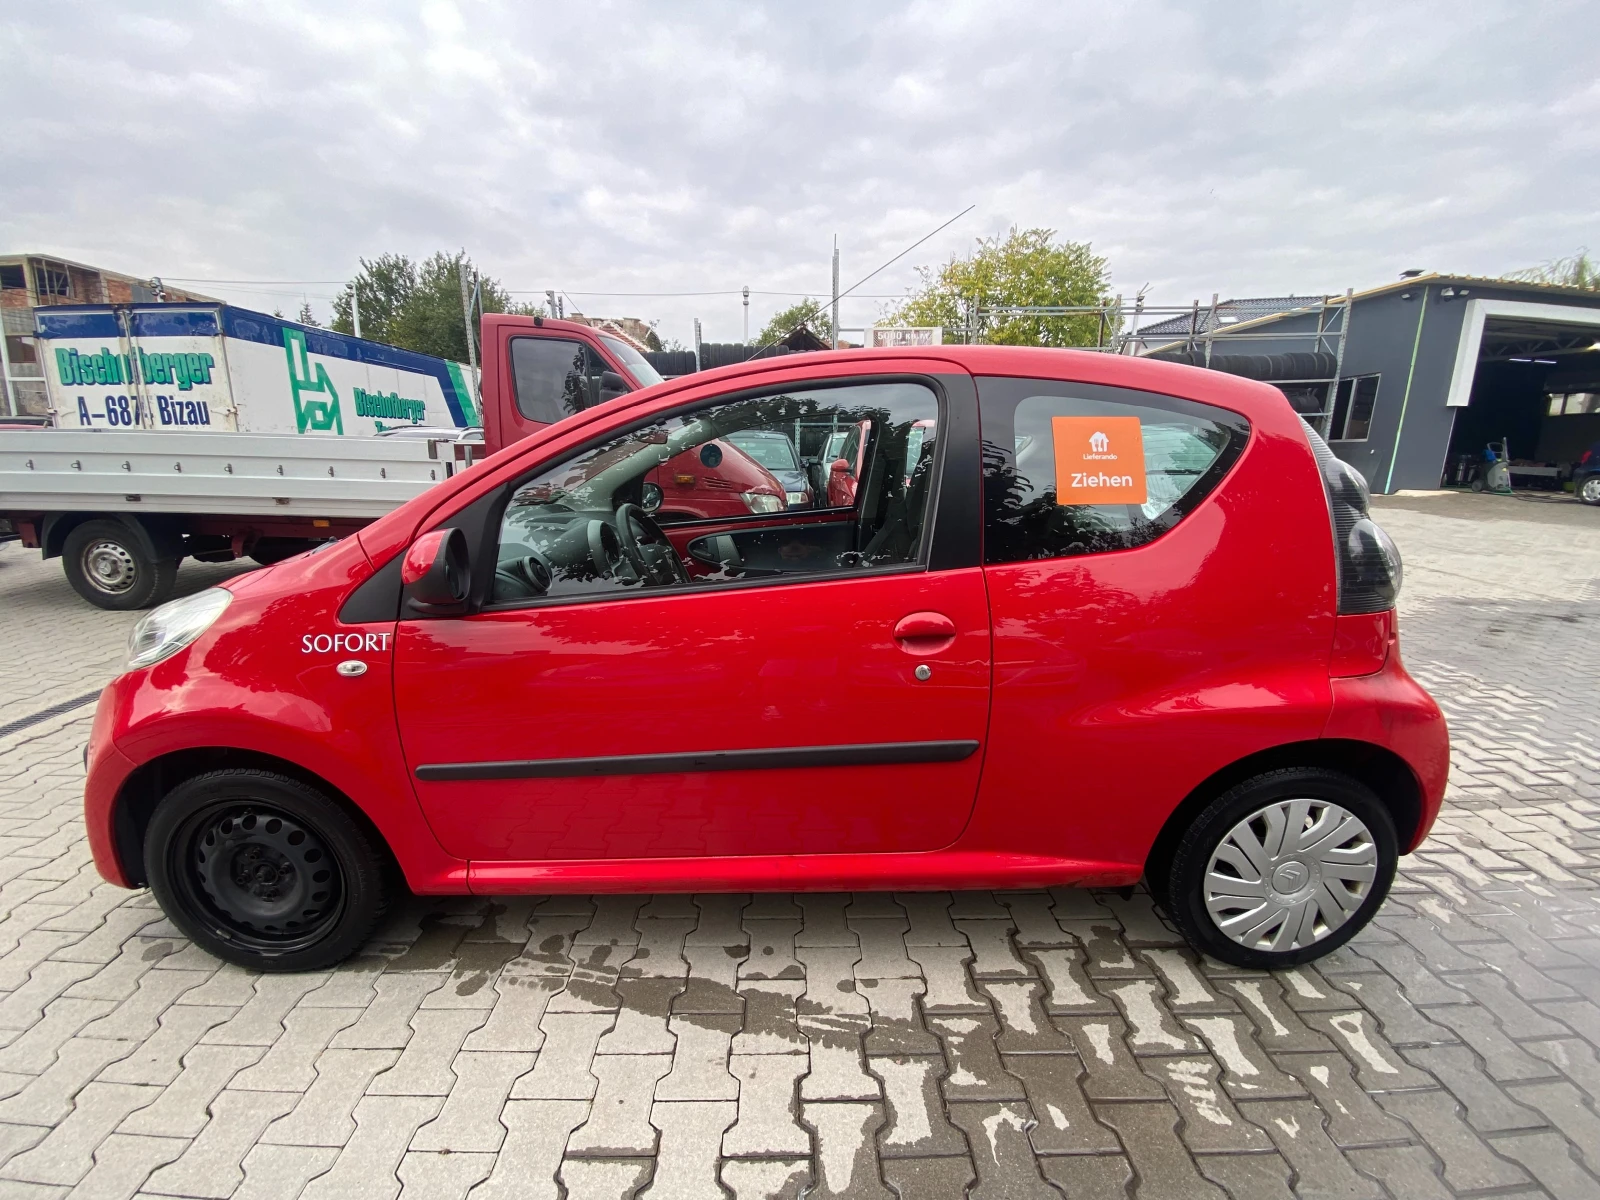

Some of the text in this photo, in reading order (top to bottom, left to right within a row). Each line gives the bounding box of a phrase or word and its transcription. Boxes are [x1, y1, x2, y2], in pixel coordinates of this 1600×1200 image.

[77, 395, 211, 426] A-687 Bizau
[353, 387, 426, 424] Bischofberger
[1071, 472, 1133, 488] Ziehen
[301, 632, 391, 653] SOFORT
